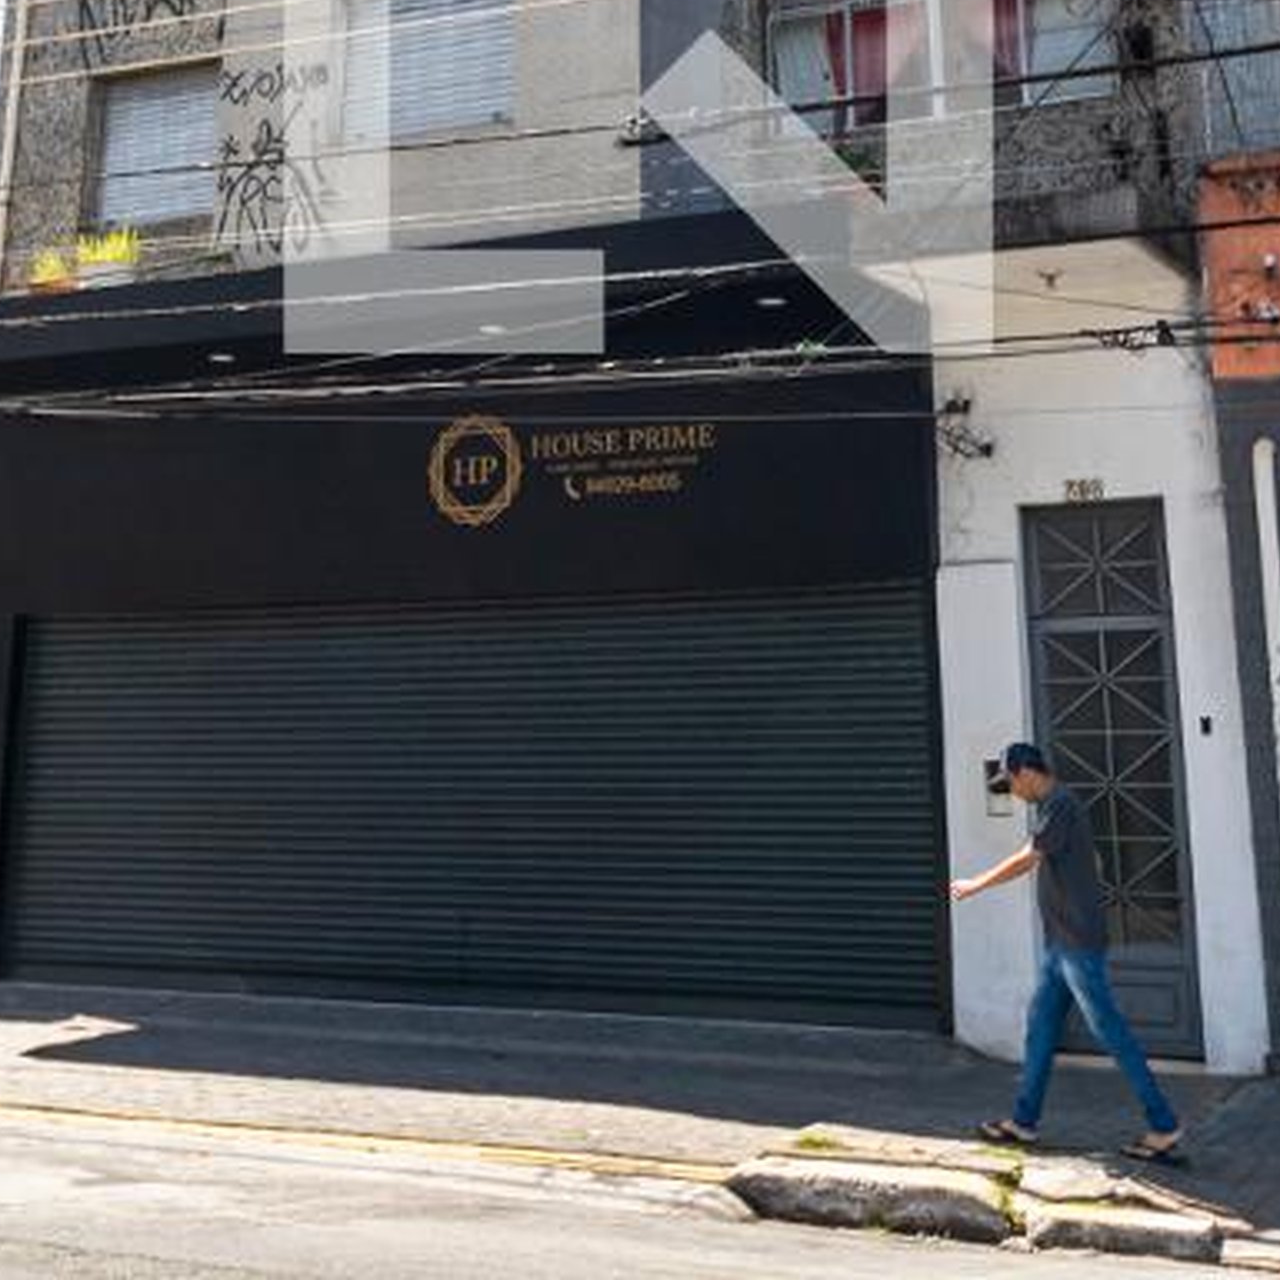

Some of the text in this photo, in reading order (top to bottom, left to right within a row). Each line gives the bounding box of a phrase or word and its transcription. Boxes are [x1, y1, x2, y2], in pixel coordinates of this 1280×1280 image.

[531, 423, 716, 460] HOUSE PRIME
[452, 455, 499, 488] HP
